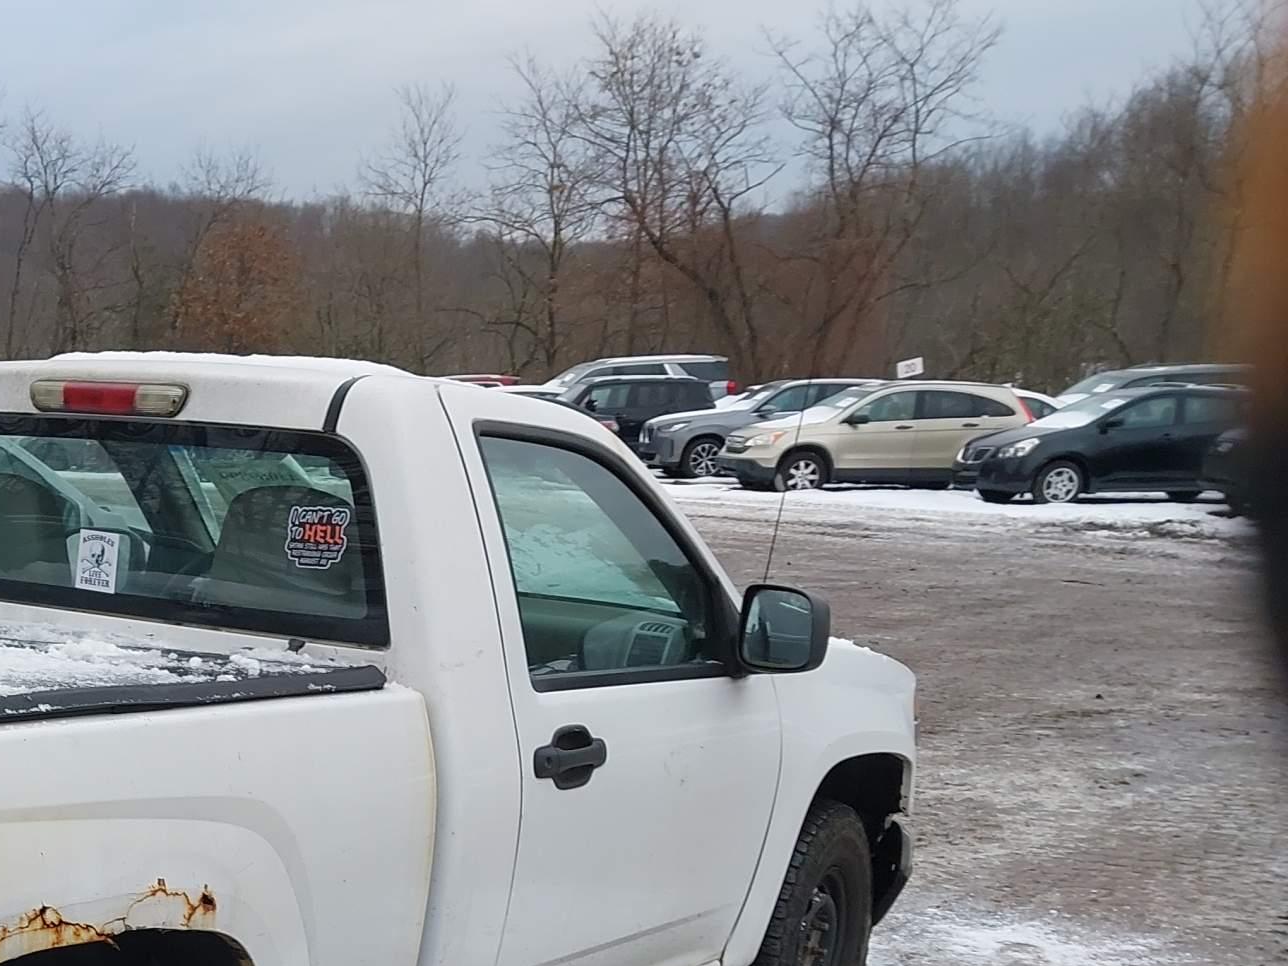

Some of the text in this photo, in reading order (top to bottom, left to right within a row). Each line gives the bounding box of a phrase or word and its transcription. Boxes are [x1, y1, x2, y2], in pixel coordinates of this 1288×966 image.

[332, 512, 346, 525] GO
[291, 524, 343, 544] TO HELL
